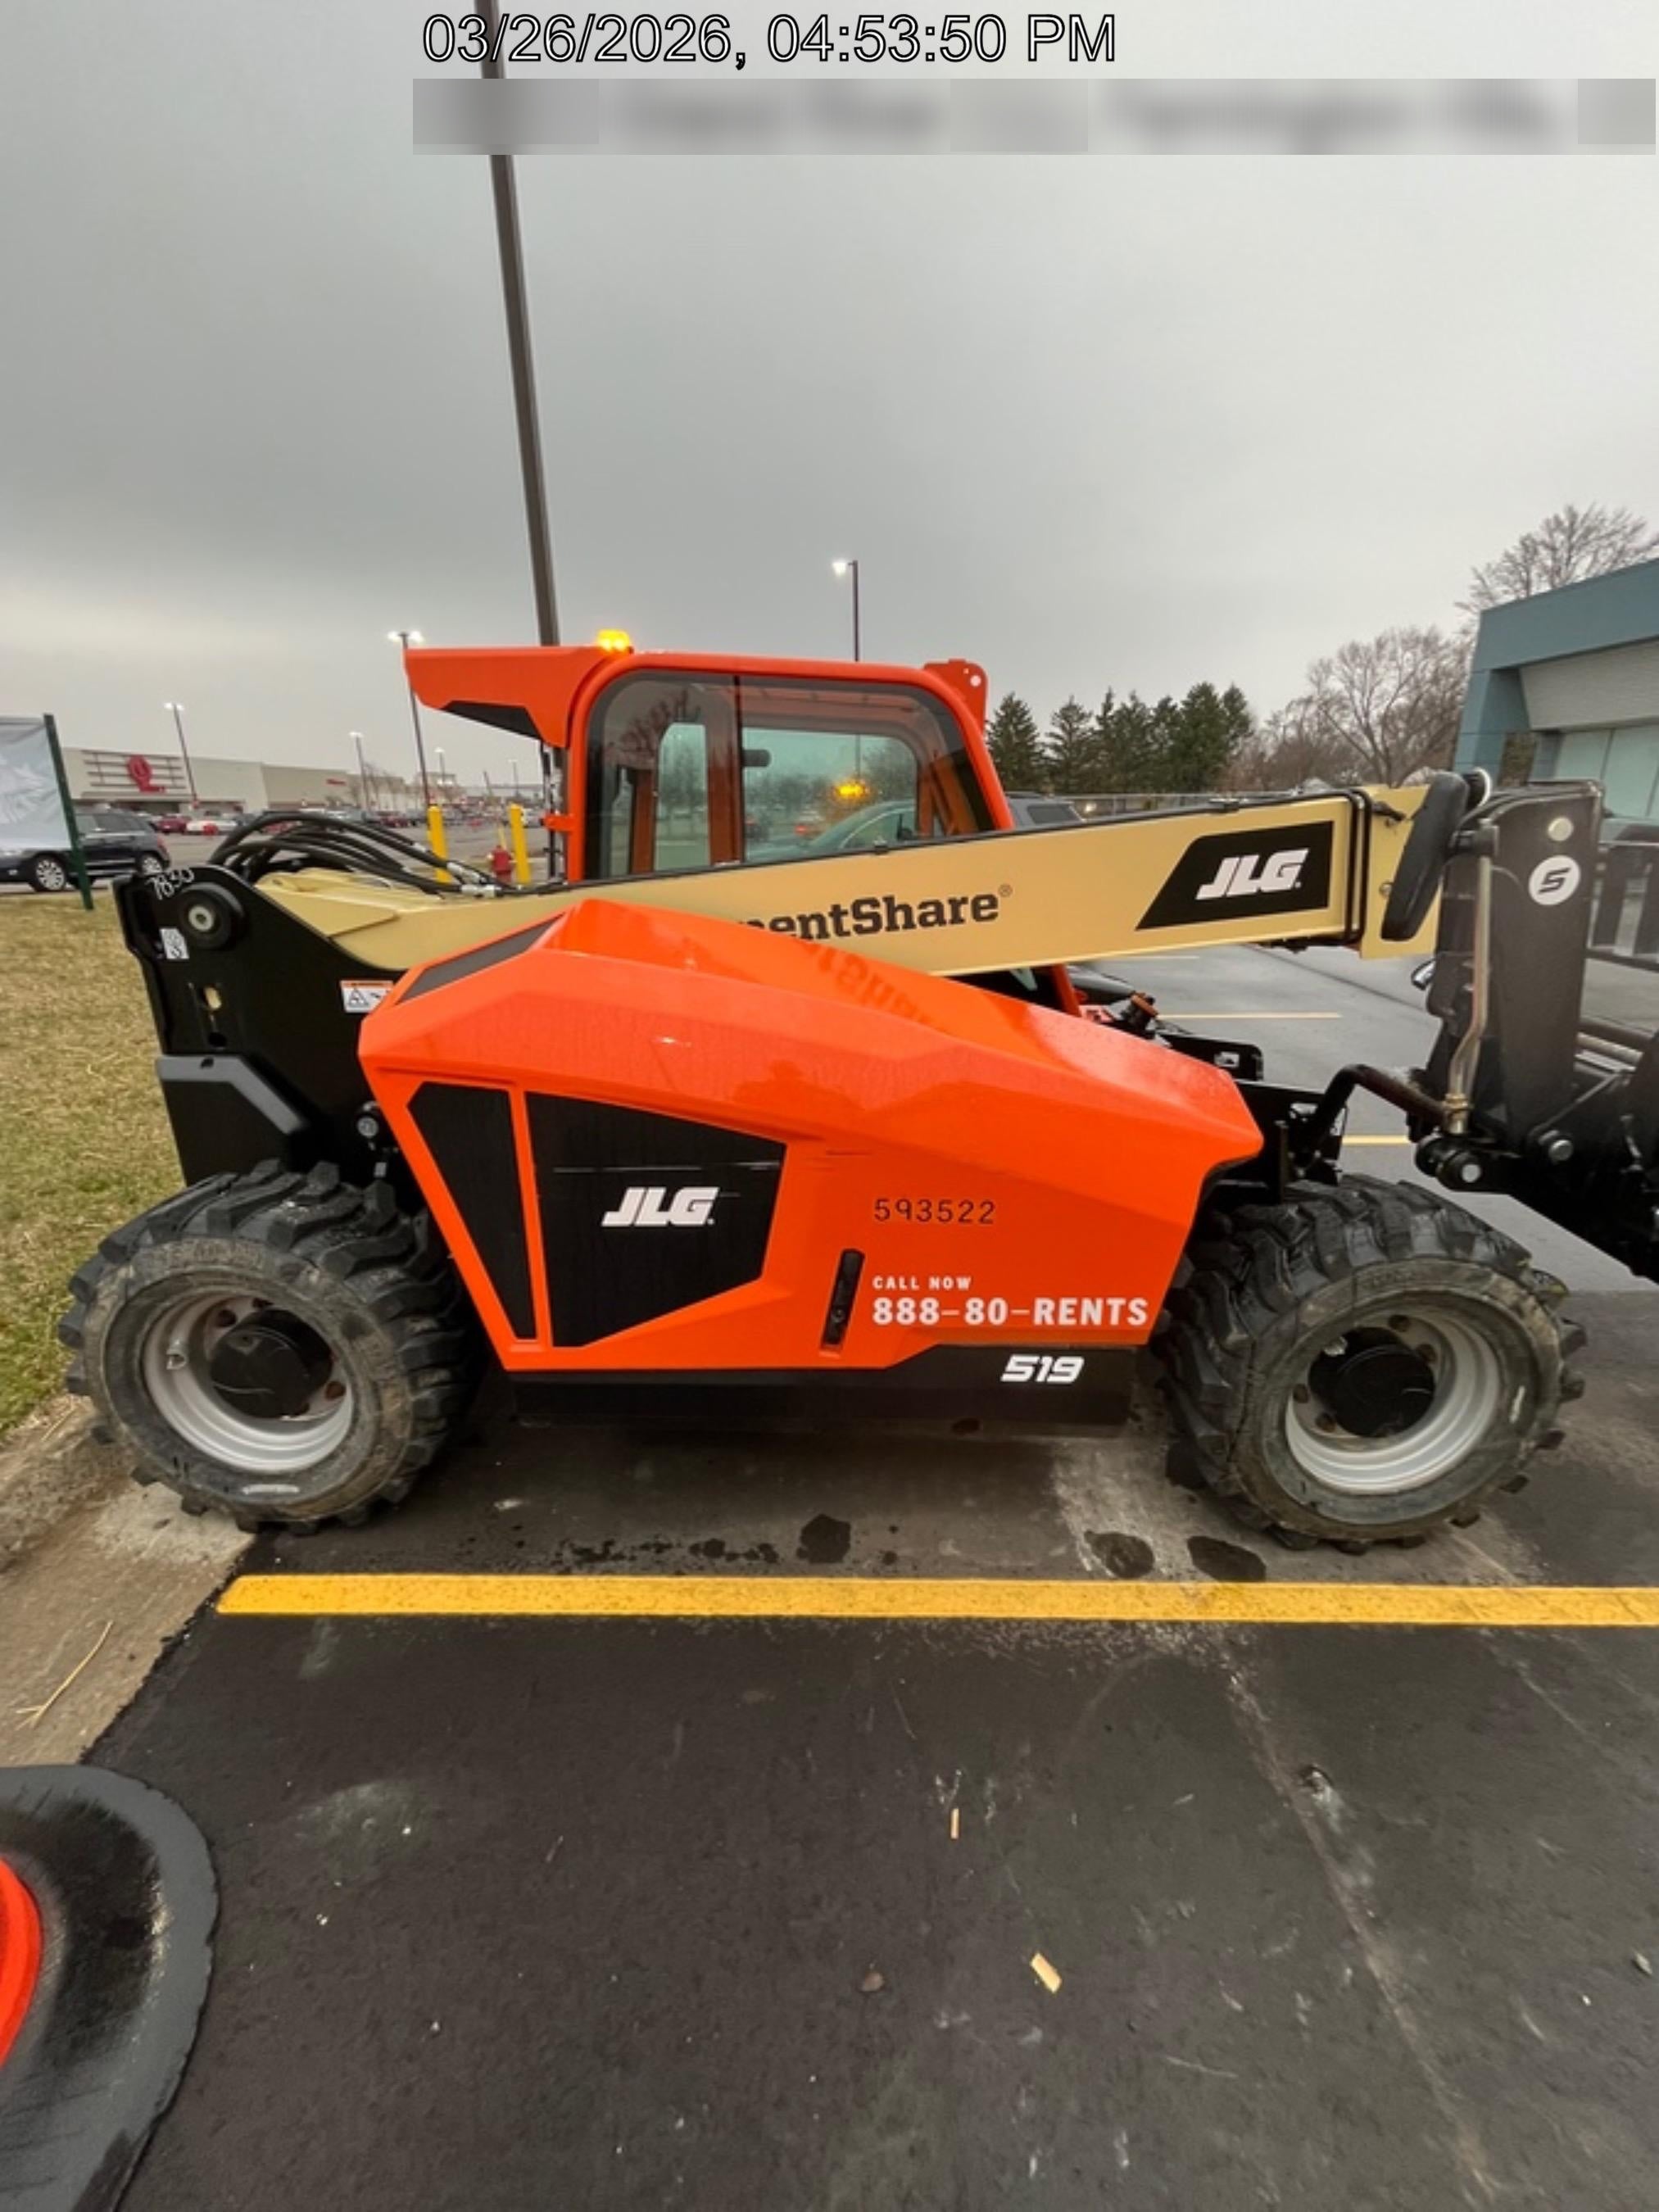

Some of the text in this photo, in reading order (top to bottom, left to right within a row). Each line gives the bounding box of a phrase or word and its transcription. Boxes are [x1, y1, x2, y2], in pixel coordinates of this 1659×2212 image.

[1195, 848, 1309, 900] JLG
[601, 1186, 720, 1227] JLG
[873, 1198, 996, 1225] 593522
[872, 1276, 972, 1290] CALL NOW
[872, 1297, 1149, 1326] 888-80-RENTS
[999, 1354, 1086, 1384] 519
